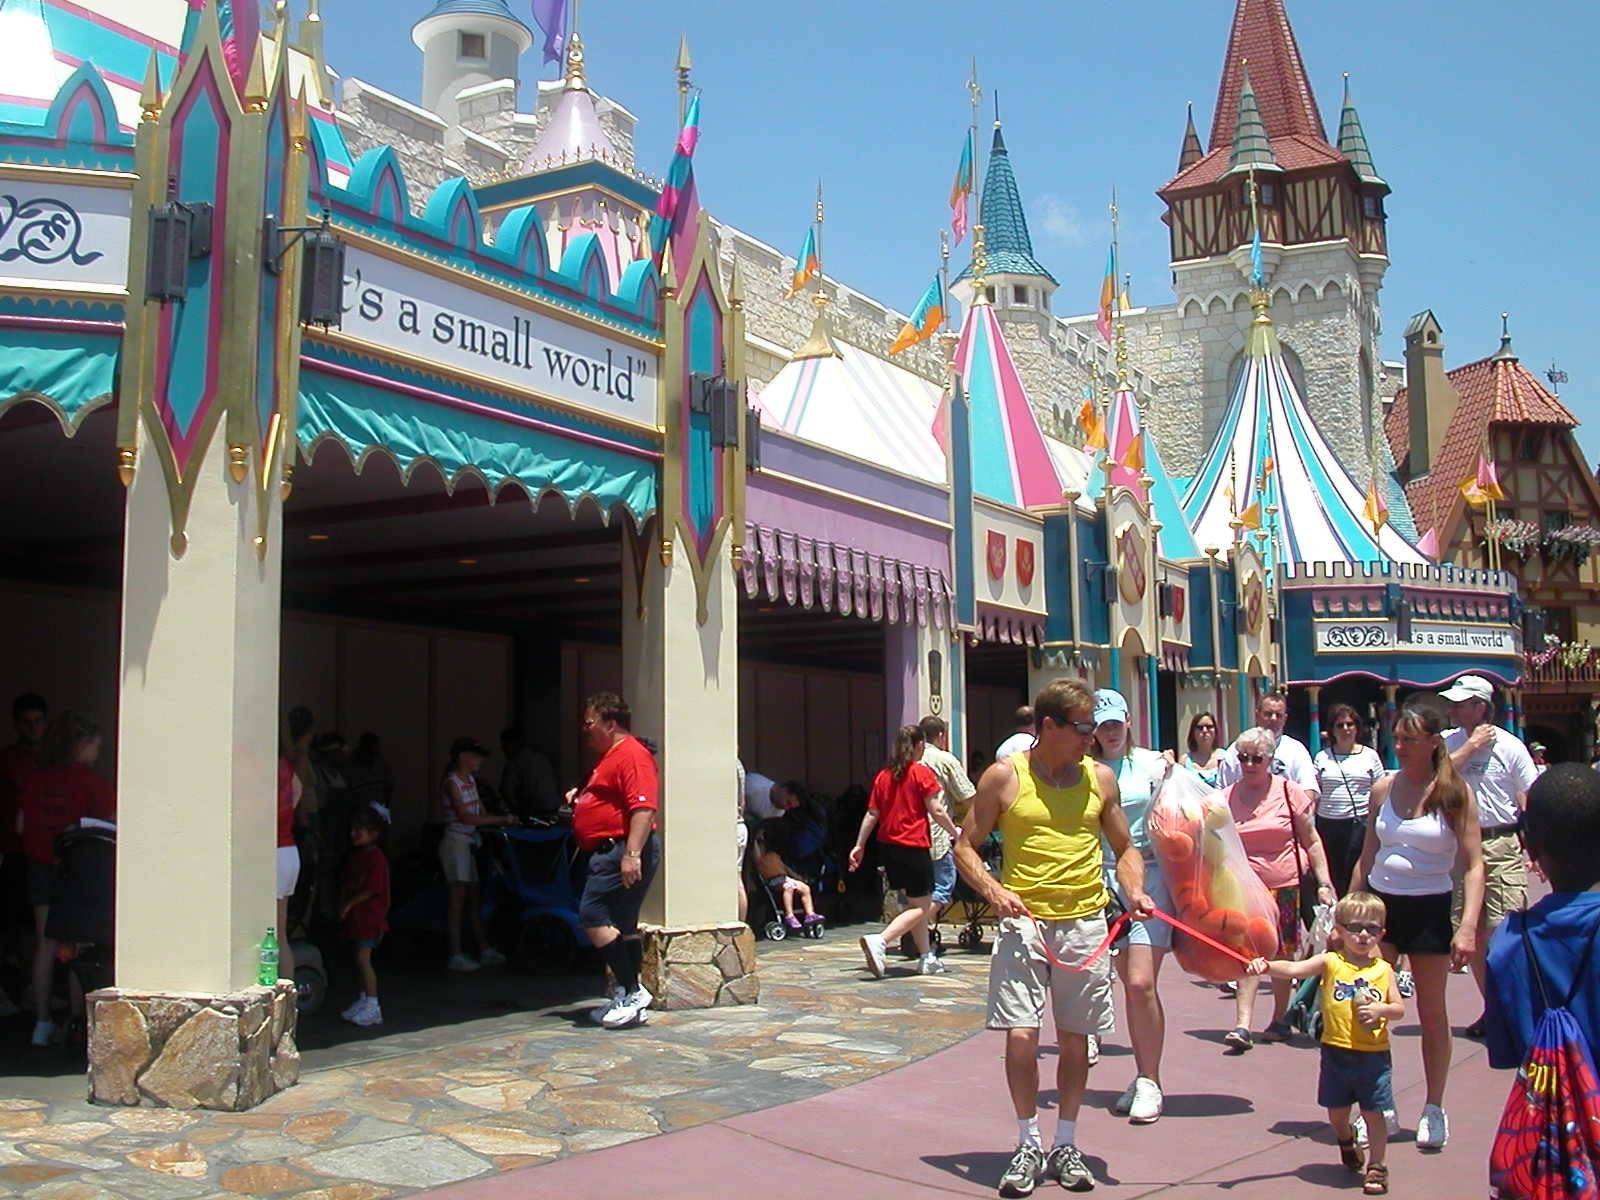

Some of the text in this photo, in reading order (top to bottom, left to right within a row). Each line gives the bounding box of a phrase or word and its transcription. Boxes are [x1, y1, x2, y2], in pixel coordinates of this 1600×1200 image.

[398, 298, 421, 335] a
[432, 311, 533, 370] small
[1427, 633, 1434, 645] a
[1437, 628, 1468, 646] small
